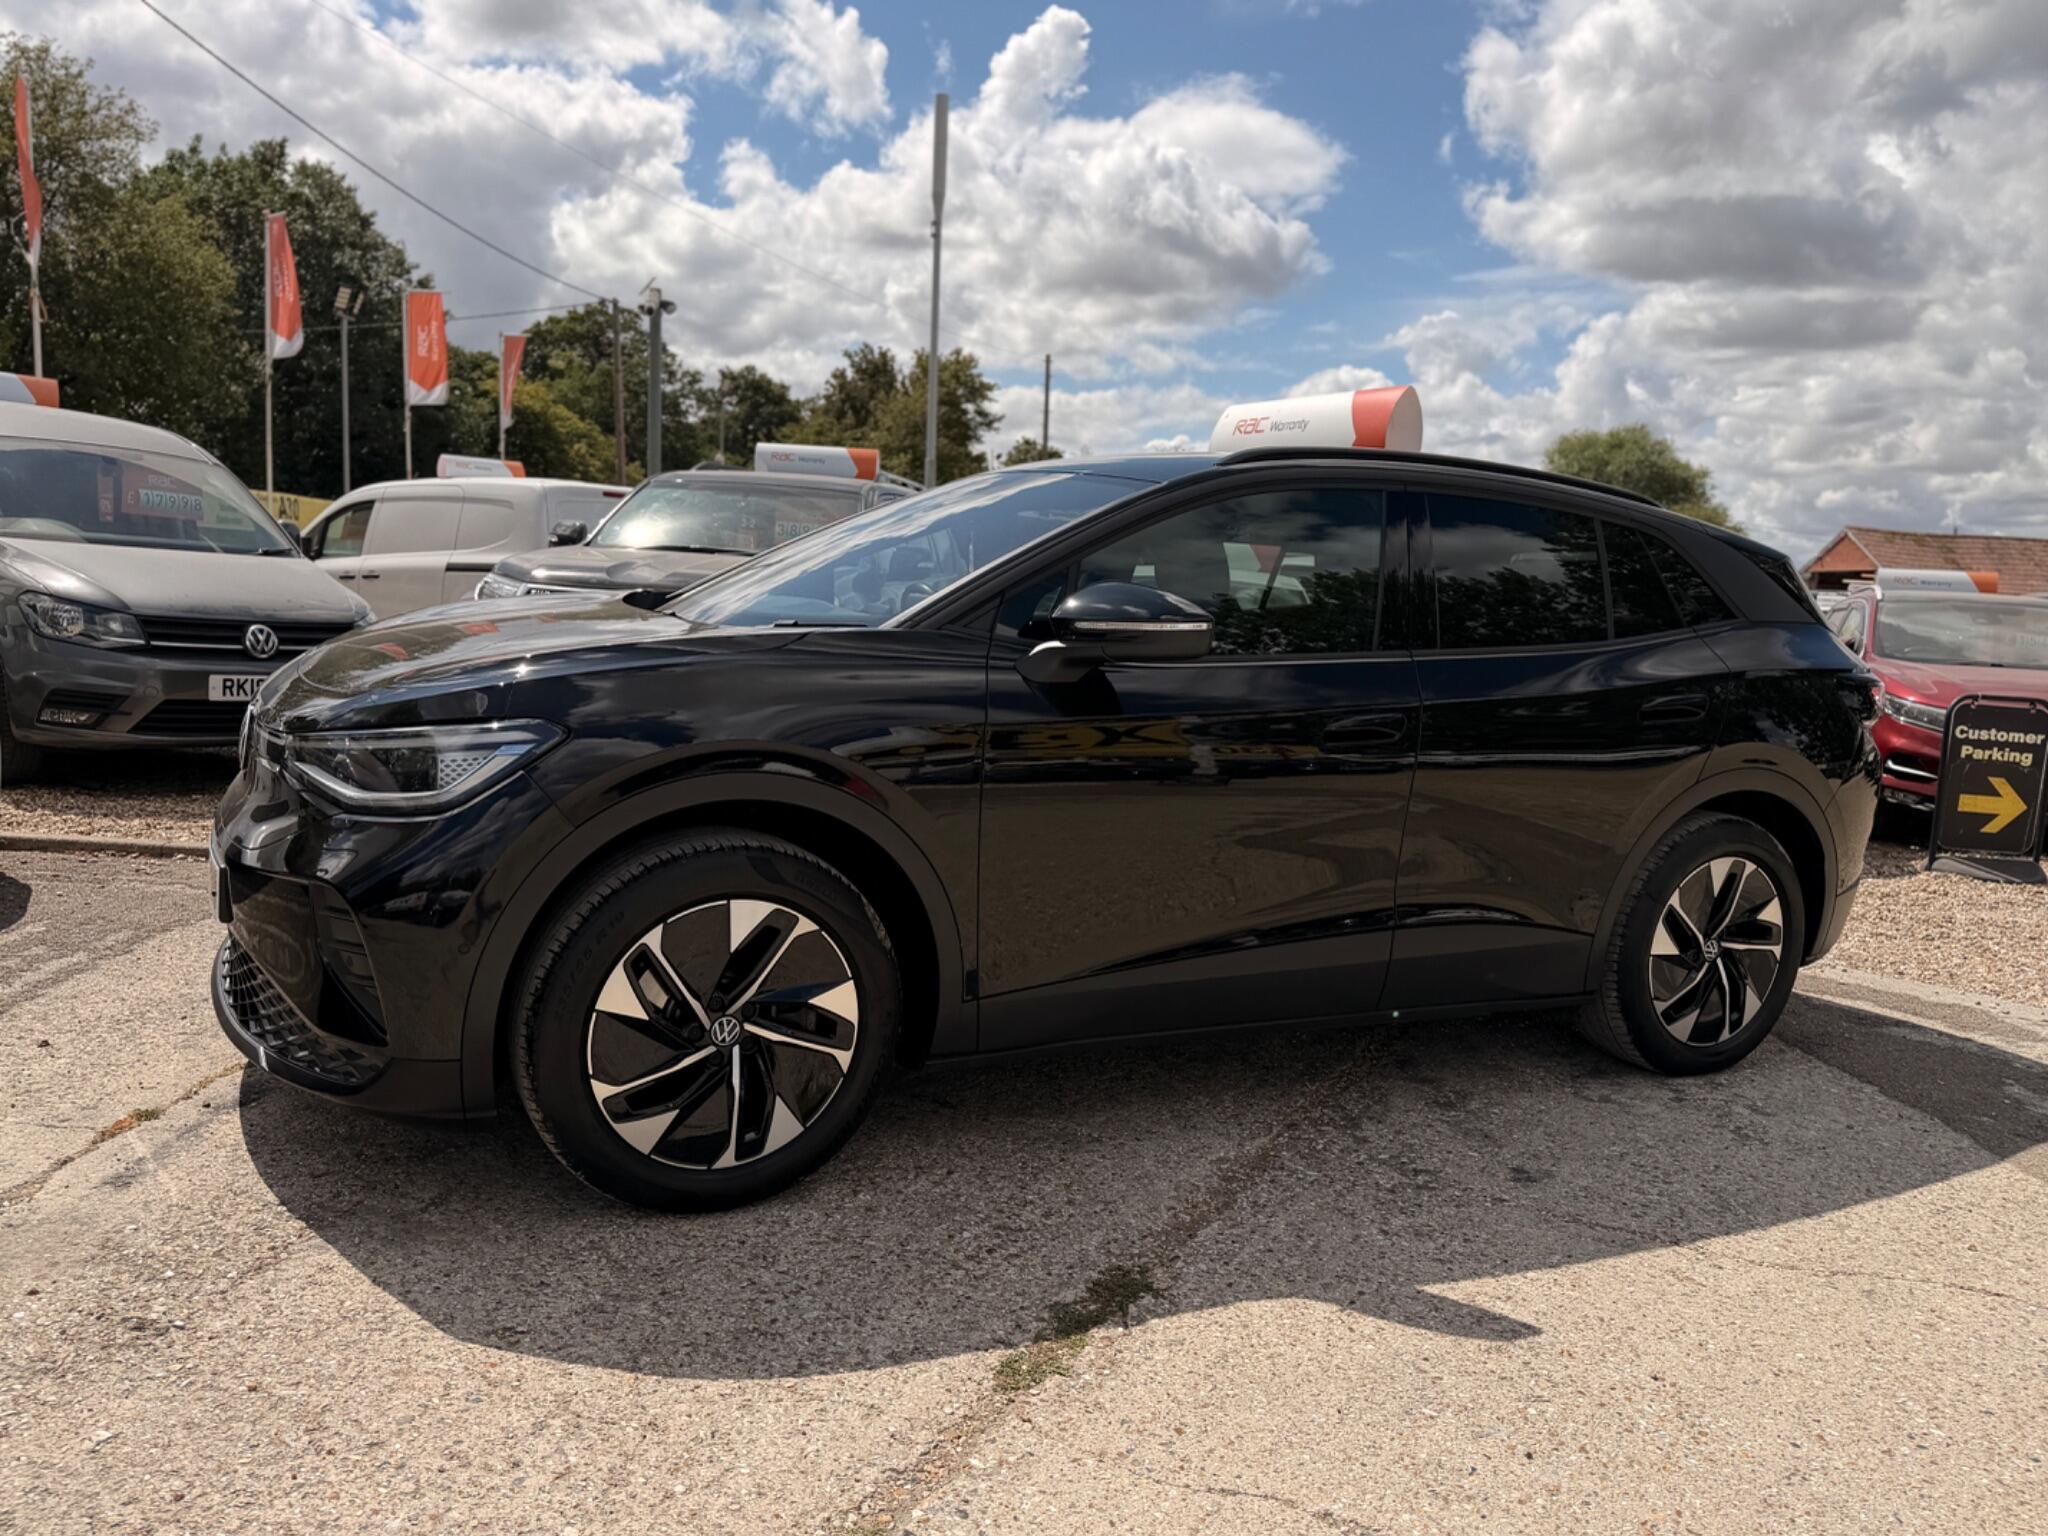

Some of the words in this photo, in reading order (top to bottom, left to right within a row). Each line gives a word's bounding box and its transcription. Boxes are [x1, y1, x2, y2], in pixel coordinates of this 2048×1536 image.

[1233, 416, 1270, 436] RAC
[1270, 418, 1311, 433] Warranty
[1954, 724, 2046, 745] Customer
[1960, 744, 2033, 767] Parking
